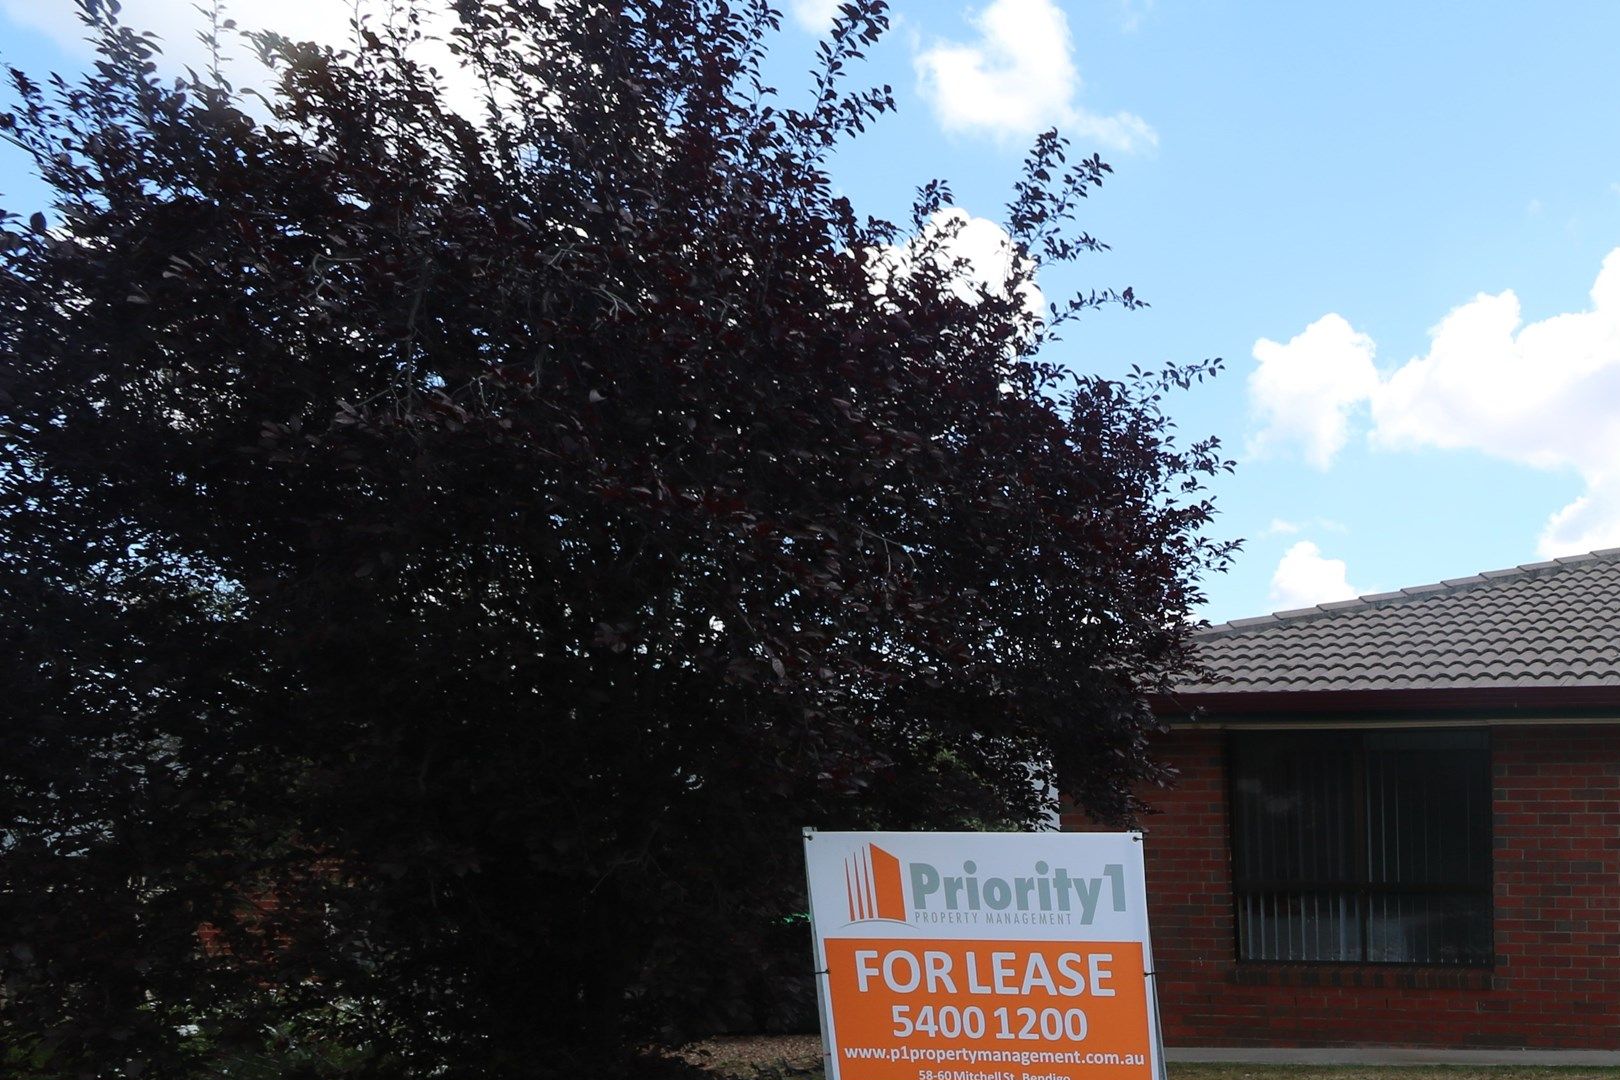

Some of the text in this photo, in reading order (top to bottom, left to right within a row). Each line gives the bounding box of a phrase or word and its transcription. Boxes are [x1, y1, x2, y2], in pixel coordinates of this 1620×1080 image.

[909, 859, 1127, 925] Priority1
[914, 911, 1072, 925] PROPERTY MANAGEMENT
[854, 949, 1116, 997] FOR LEASE
[891, 1005, 1088, 1041] 5400 1200
[844, 1045, 1145, 1066] www.p1propertymanagement.com.au
